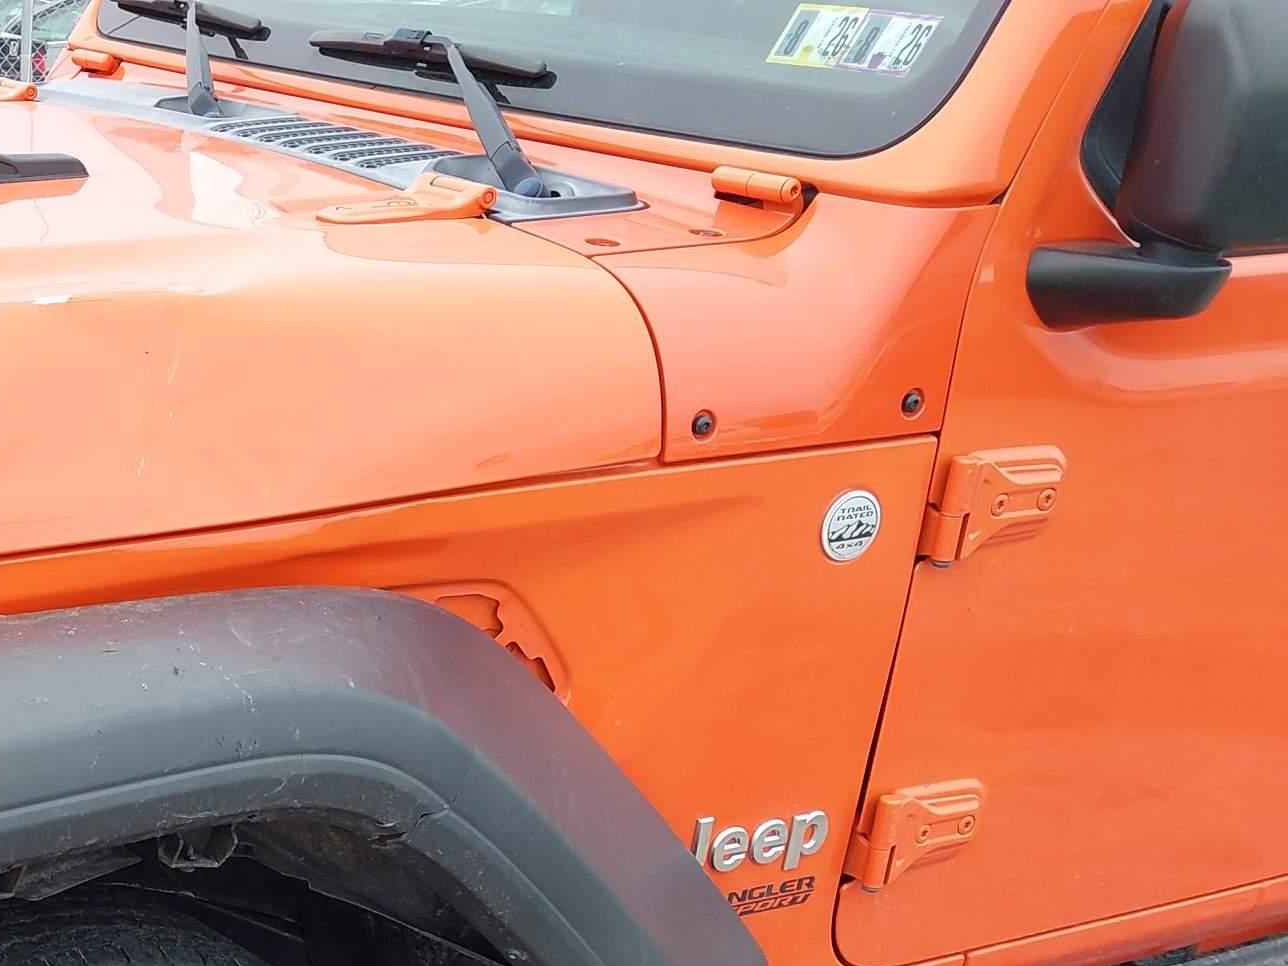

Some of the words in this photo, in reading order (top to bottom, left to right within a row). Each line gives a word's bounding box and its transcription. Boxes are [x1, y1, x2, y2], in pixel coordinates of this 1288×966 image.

[822, 16, 860, 57] 26
[892, 24, 933, 66] 26
[837, 511, 874, 521] RATED
[840, 505, 872, 514] TRAIL
[691, 809, 830, 872] Jeep
[727, 876, 816, 904] NGLER
[731, 893, 811, 916] PORT
